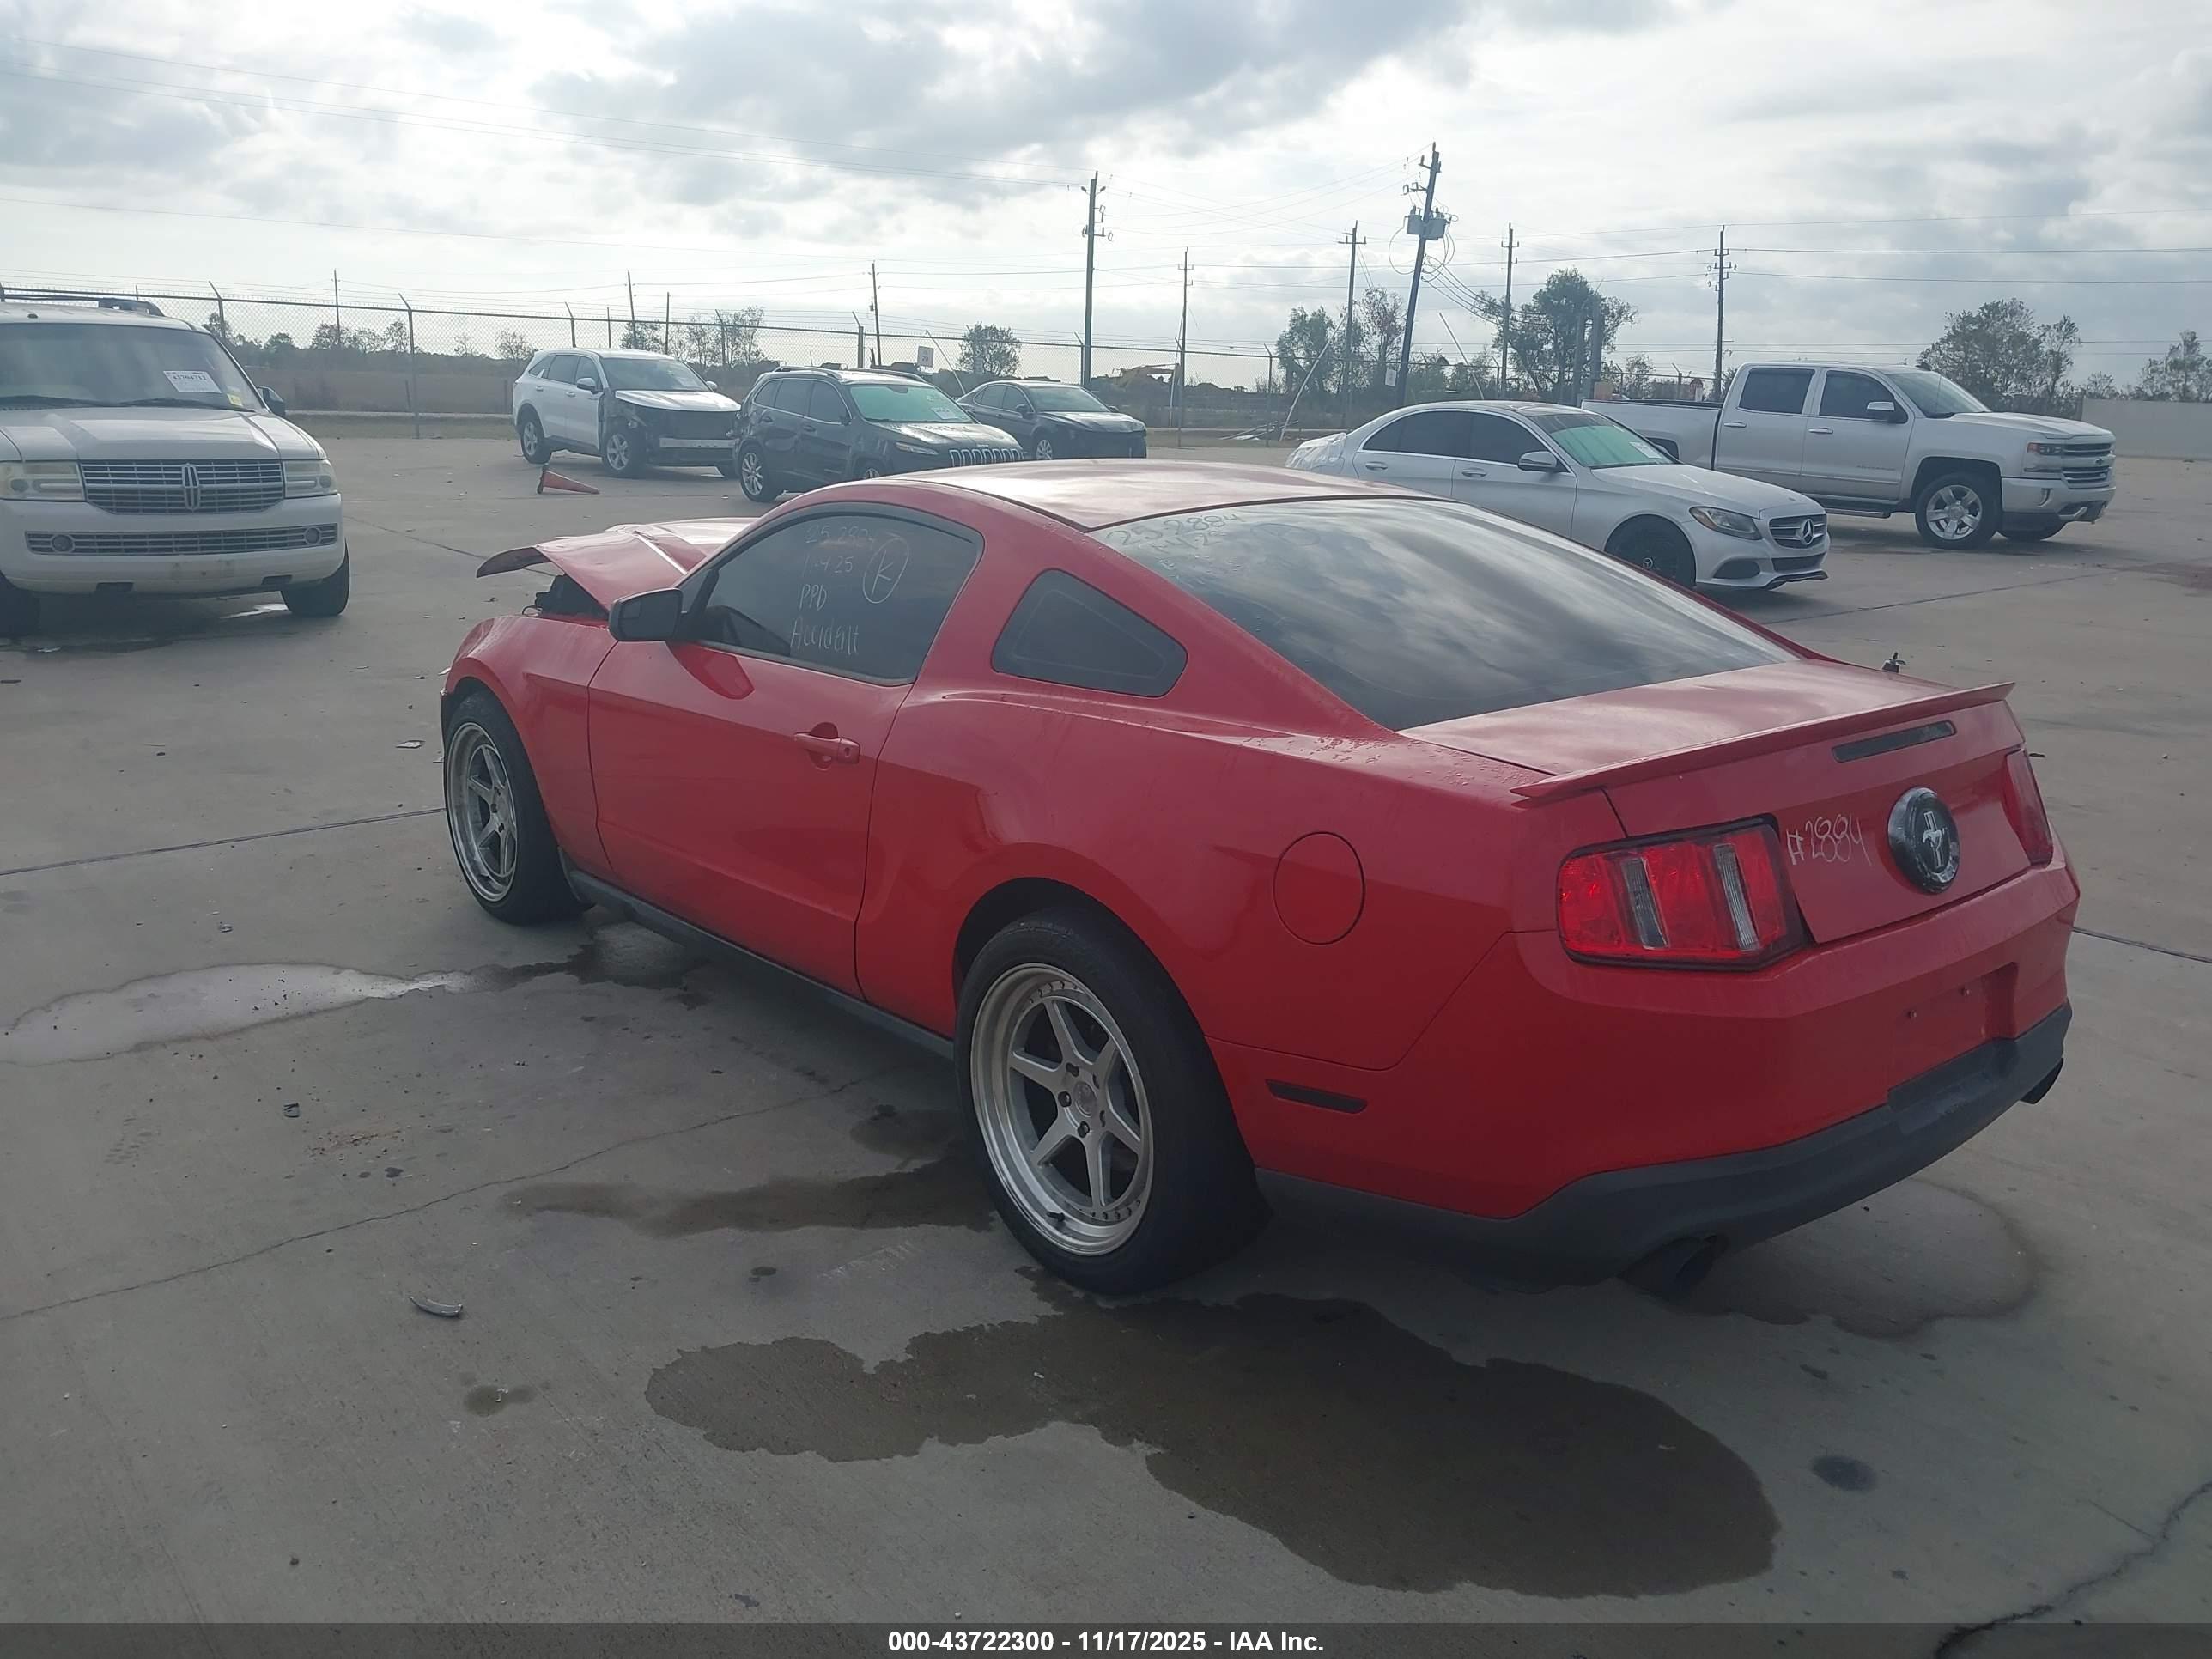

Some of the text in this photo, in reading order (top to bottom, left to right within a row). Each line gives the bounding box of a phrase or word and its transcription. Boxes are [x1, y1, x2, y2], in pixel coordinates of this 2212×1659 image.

[872, 550, 892, 596] K
[799, 584, 827, 611] PPD
[1786, 814, 1873, 866] #2884
